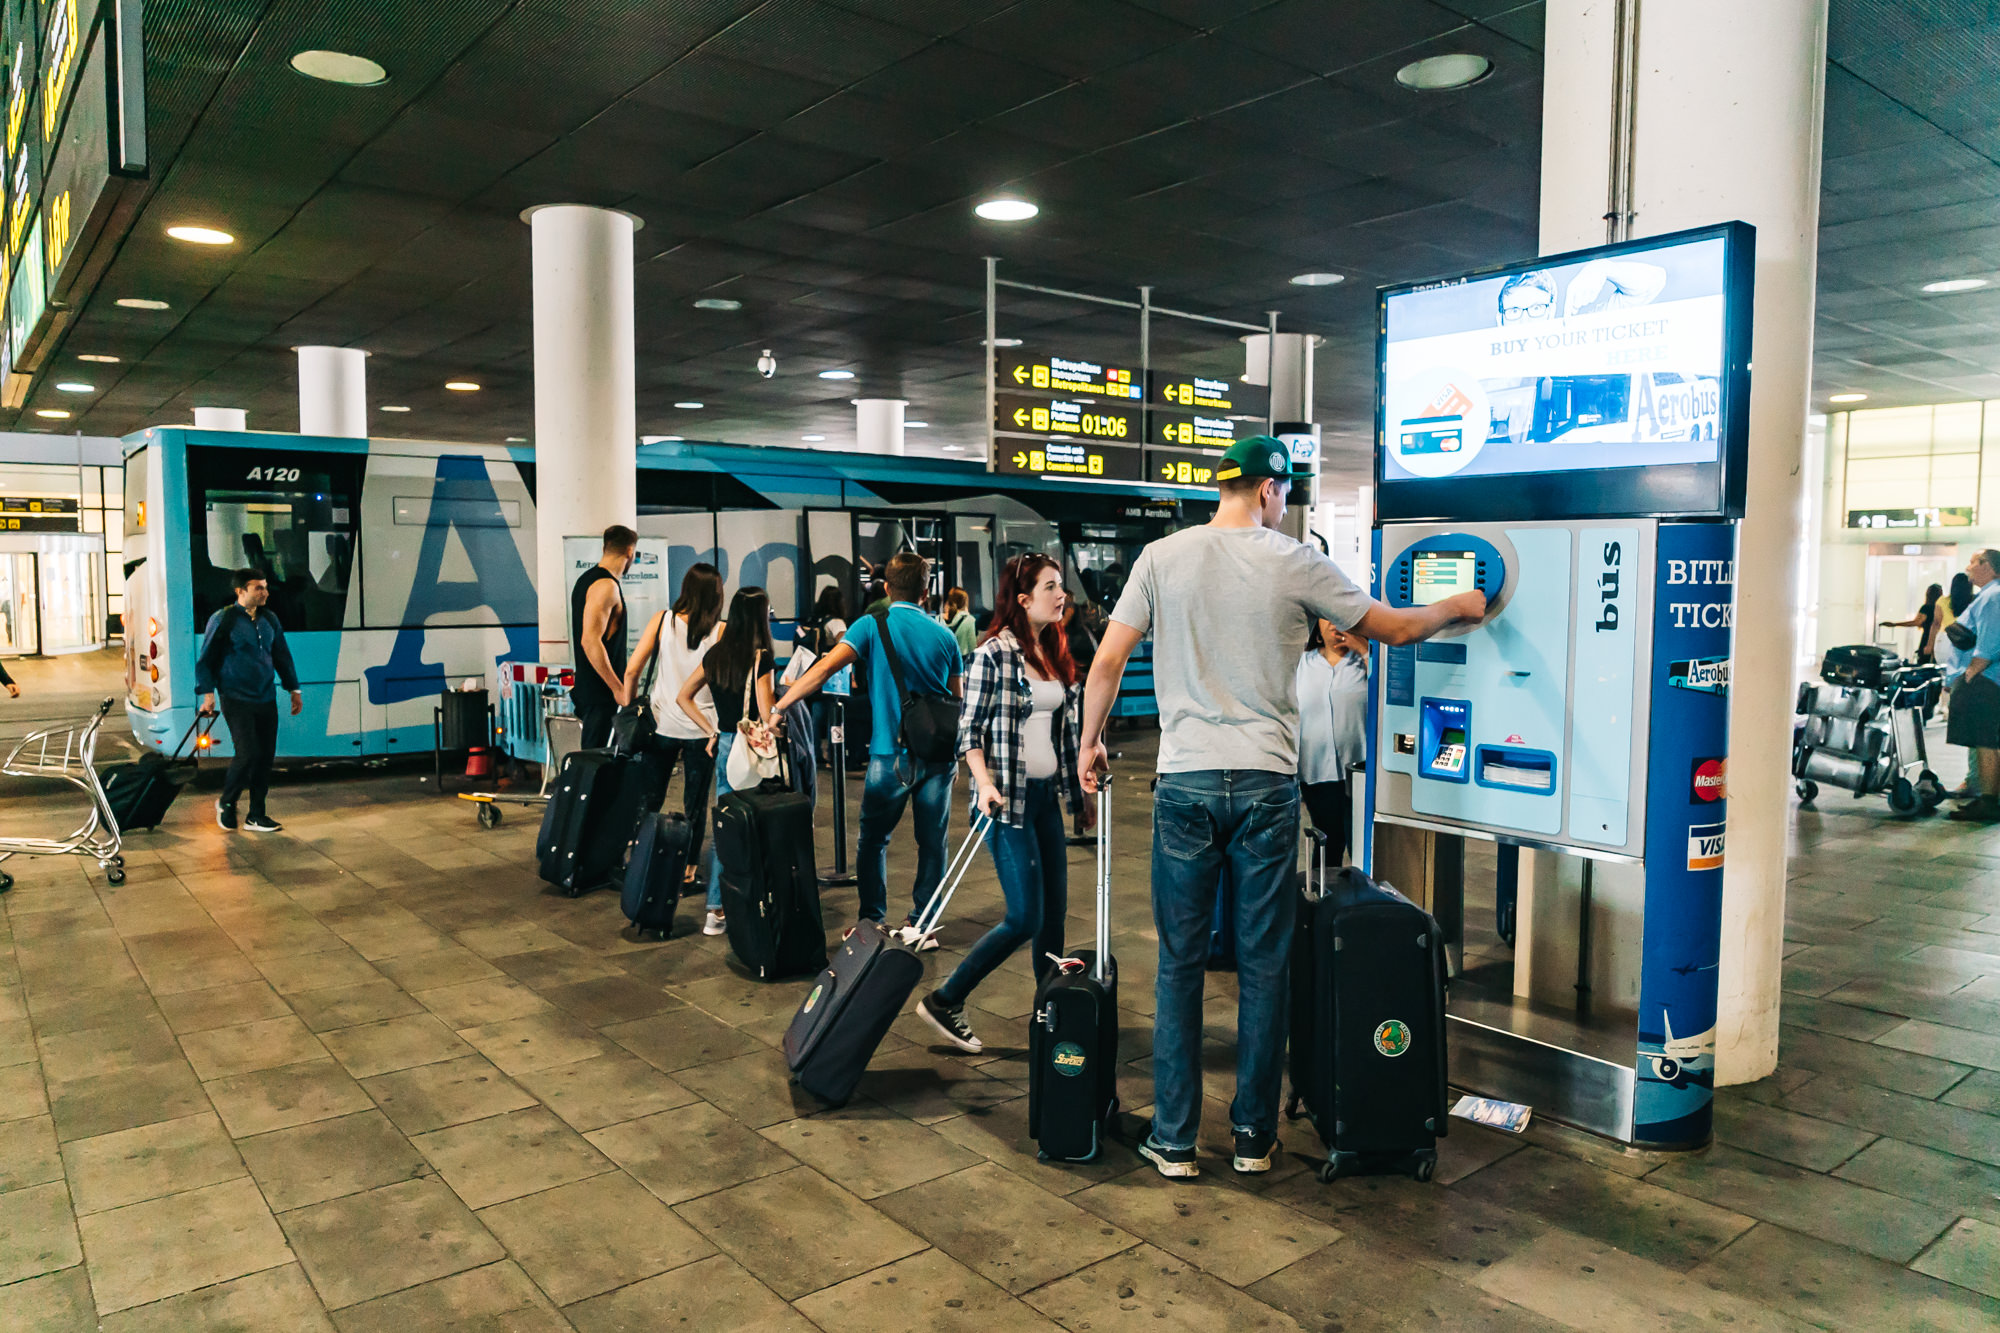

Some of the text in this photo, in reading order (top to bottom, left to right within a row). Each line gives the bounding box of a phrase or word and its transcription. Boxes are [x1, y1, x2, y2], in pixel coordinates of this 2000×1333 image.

[1490, 319, 1669, 356] BUY YOUR TICKET
[1607, 345, 1669, 367] HERE
[246, 466, 301, 482] A120
[1193, 467, 1212, 483] VIP
[1914, 508, 1941, 528] T1
[1595, 541, 1621, 633] bús
[1670, 603, 1733, 628] TICK
[1689, 660, 1731, 683] Aerobú
